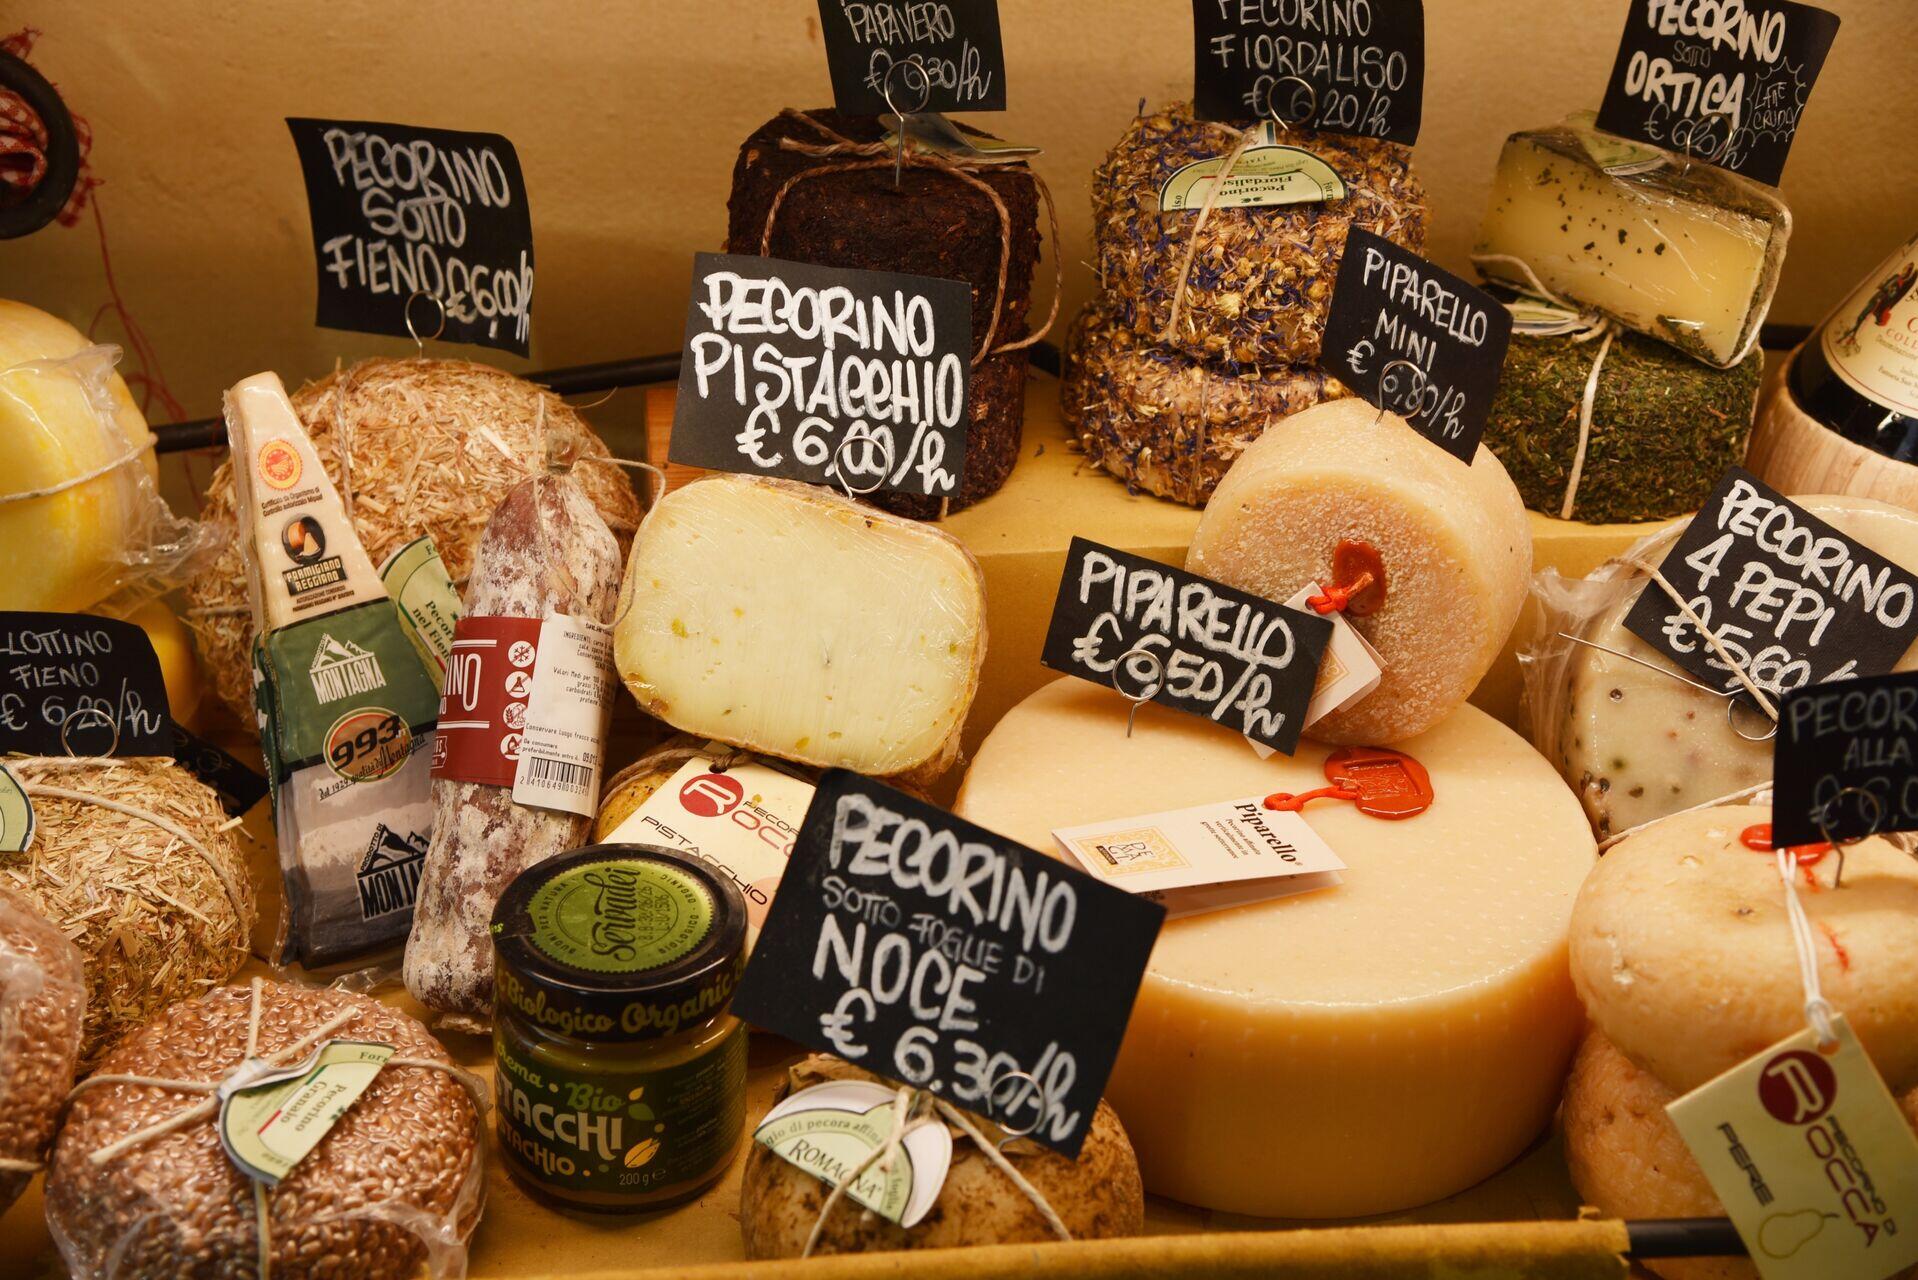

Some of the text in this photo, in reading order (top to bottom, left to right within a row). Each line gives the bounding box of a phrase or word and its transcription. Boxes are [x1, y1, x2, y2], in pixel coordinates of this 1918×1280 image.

[845, 2, 955, 45] PAPAVERO
[1218, 0, 1372, 36] PECORINO
[1647, 0, 1786, 63] PECORINO
[1210, 33, 1408, 91] FIORDALISO
[1624, 50, 1745, 130] ORTICA
[323, 128, 511, 208] PECORINO
[1219, 184, 1286, 197] Pecorino
[362, 185, 466, 248] SOTTO
[322, 234, 445, 301] FIENO
[1363, 247, 1488, 347] PIPARELLO
[698, 271, 935, 357] PECORINO
[1374, 307, 1437, 372] MINI
[690, 331, 963, 428] PISTACCHIO
[286, 558, 341, 582] PARMIGIANO
[295, 571, 340, 592] REGGIANO
[1717, 479, 1914, 629] PECORINO
[412, 607, 432, 628] nel
[1079, 551, 1296, 669] PIPARELLO
[1685, 533, 1836, 647] 4 PEPI
[0, 629, 113, 656] LOTTINO
[9, 661, 99, 690] FIENO
[310, 656, 387, 705] MONTAGNA
[331, 714, 401, 772] 993
[525, 723, 557, 735] Conservare
[1843, 736, 1914, 771] ALLA
[360, 831, 379, 871] PRODOTTO
[829, 793, 1077, 953] PECORINO
[583, 866, 641, 962] Servadei
[821, 876, 901, 928] SOTTO
[1013, 955, 1046, 995] DI
[507, 972, 732, 1036] Biologico Organic
[812, 913, 986, 1032] NOCE
[820, 987, 876, 1058] €
[294, 1083, 347, 1133] Pecorino
[498, 1071, 623, 1161] TACCHI
[564, 1082, 626, 1112] Bio
[807, 1117, 851, 1131] pecora
[619, 1171, 640, 1186] 200
